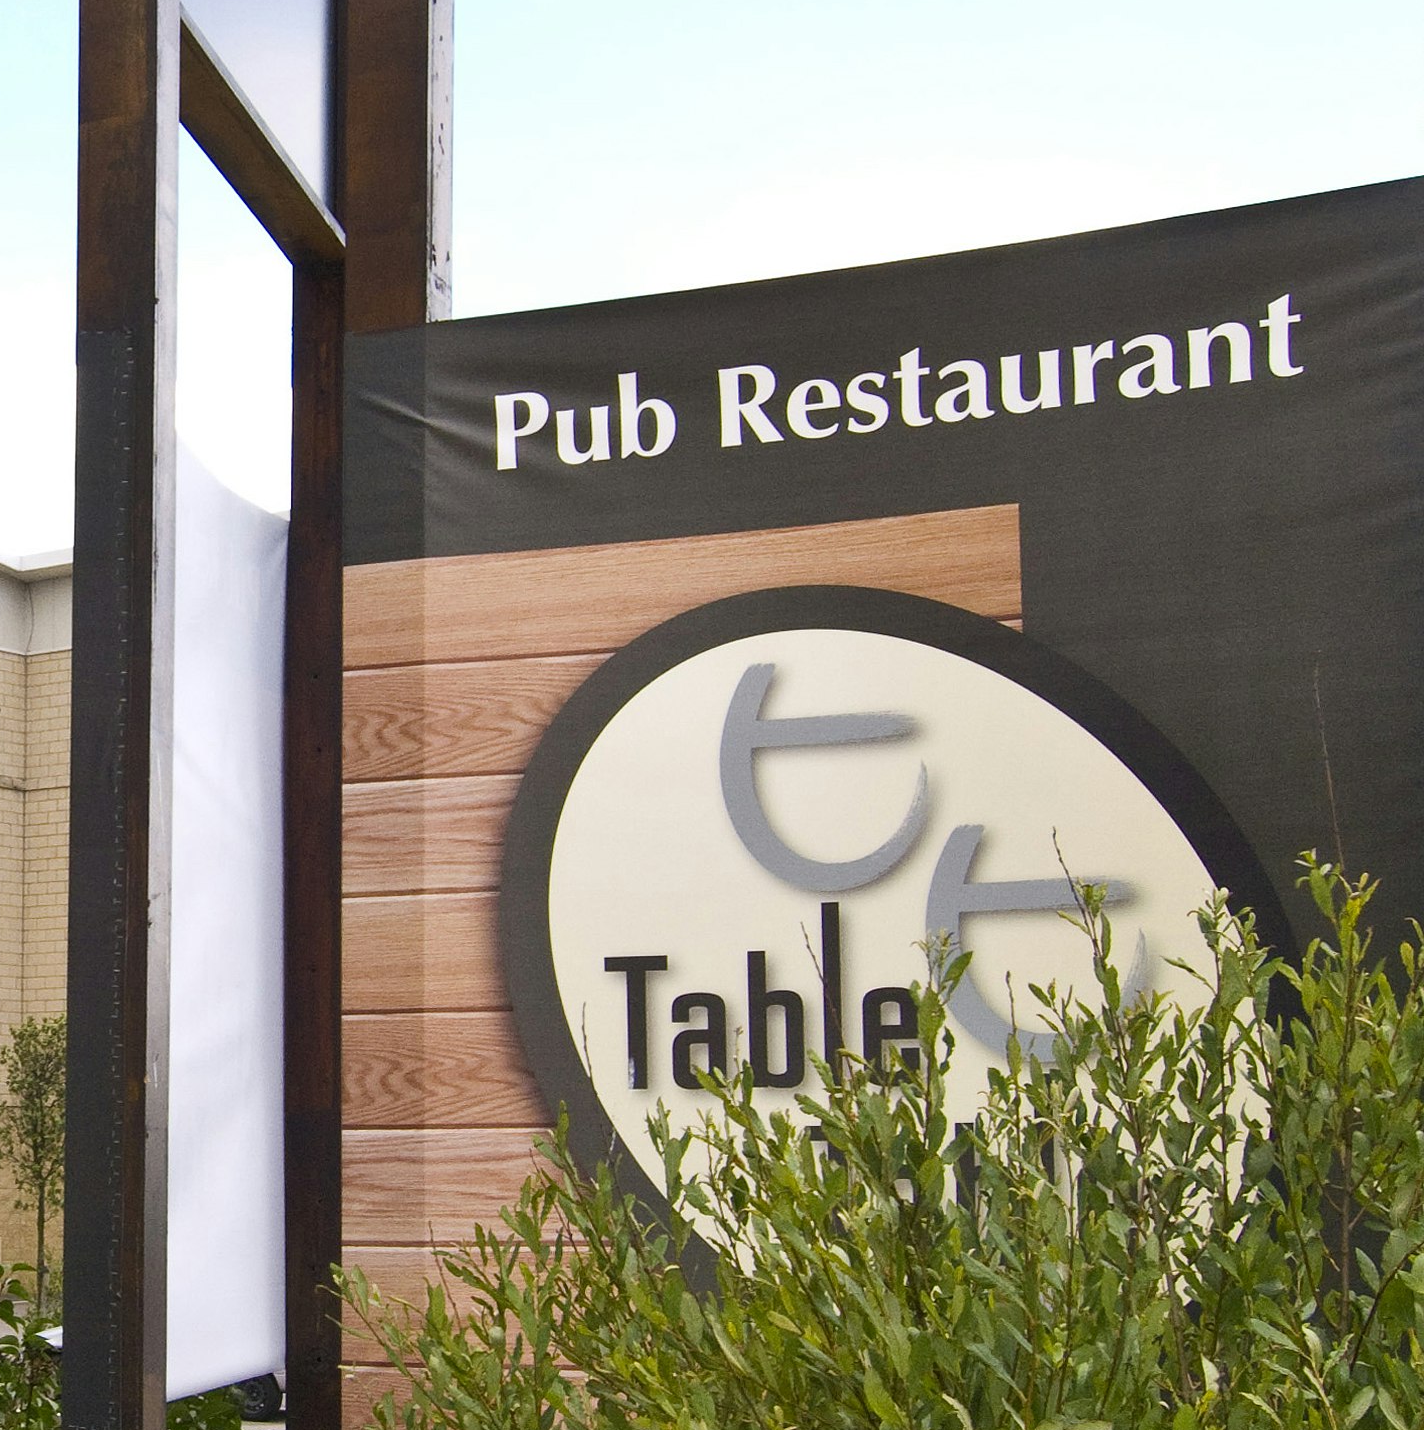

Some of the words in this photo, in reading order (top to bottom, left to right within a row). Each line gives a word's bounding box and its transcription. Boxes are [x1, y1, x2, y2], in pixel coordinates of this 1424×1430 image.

[493, 370, 678, 472] Pub
[717, 293, 1305, 449] Restaurant
[603, 901, 924, 1091] Table
